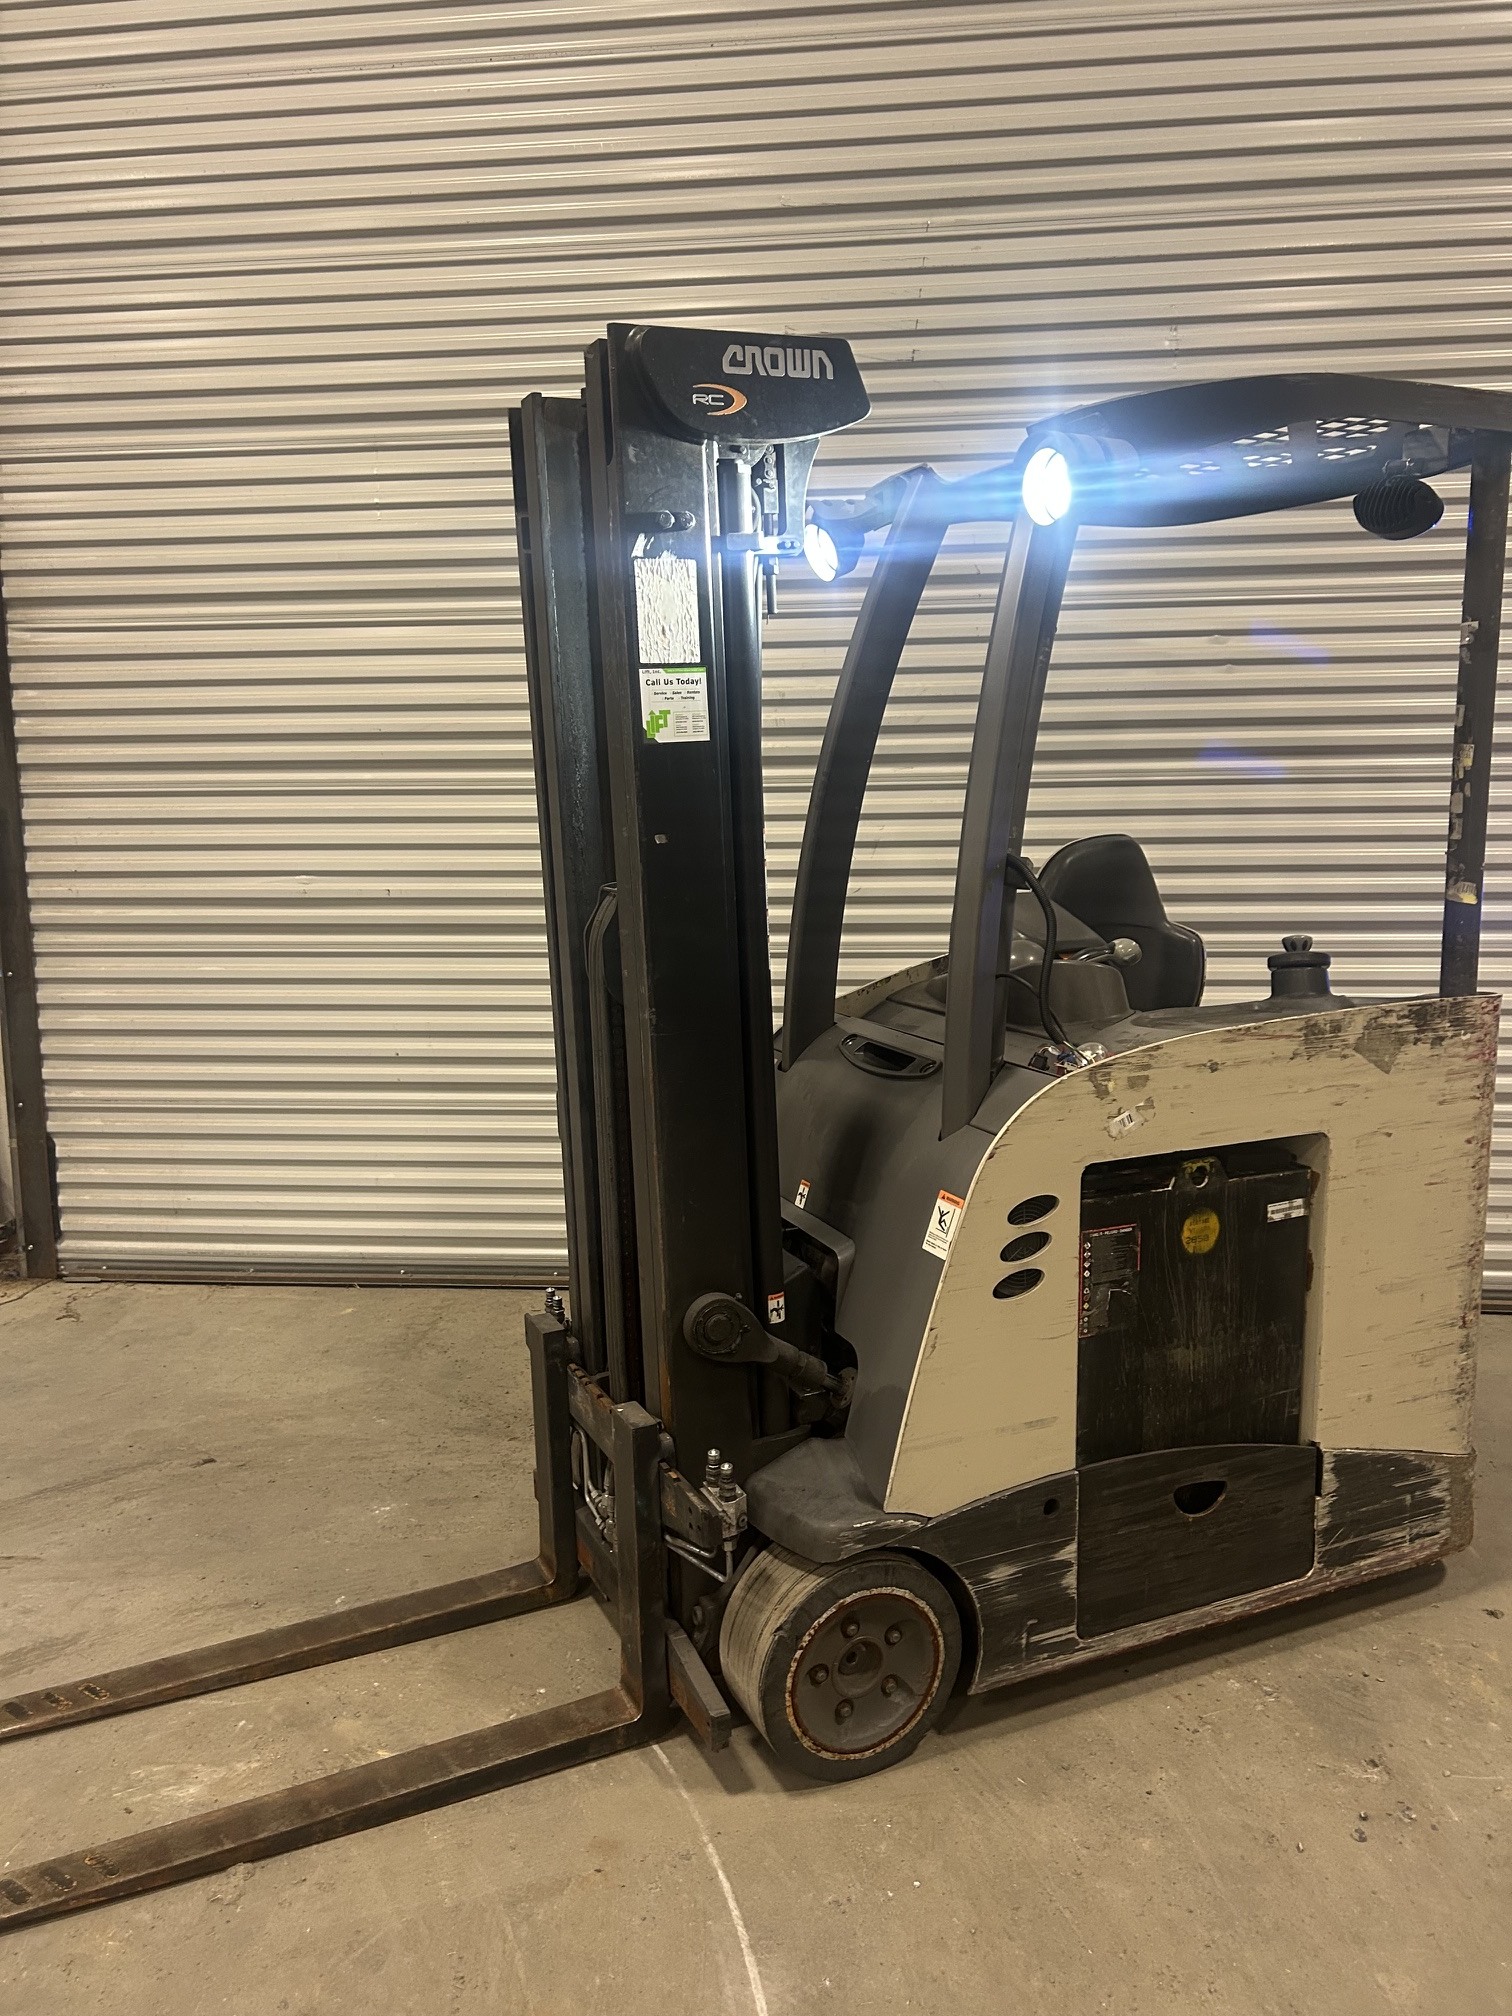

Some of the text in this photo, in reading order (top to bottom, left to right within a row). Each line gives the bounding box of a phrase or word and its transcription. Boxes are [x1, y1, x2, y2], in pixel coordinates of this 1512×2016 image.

[722, 344, 834, 380] CROWN
[692, 393, 725, 406] RC
[645, 678, 661, 686] Call
[676, 677, 702, 686] Today!
